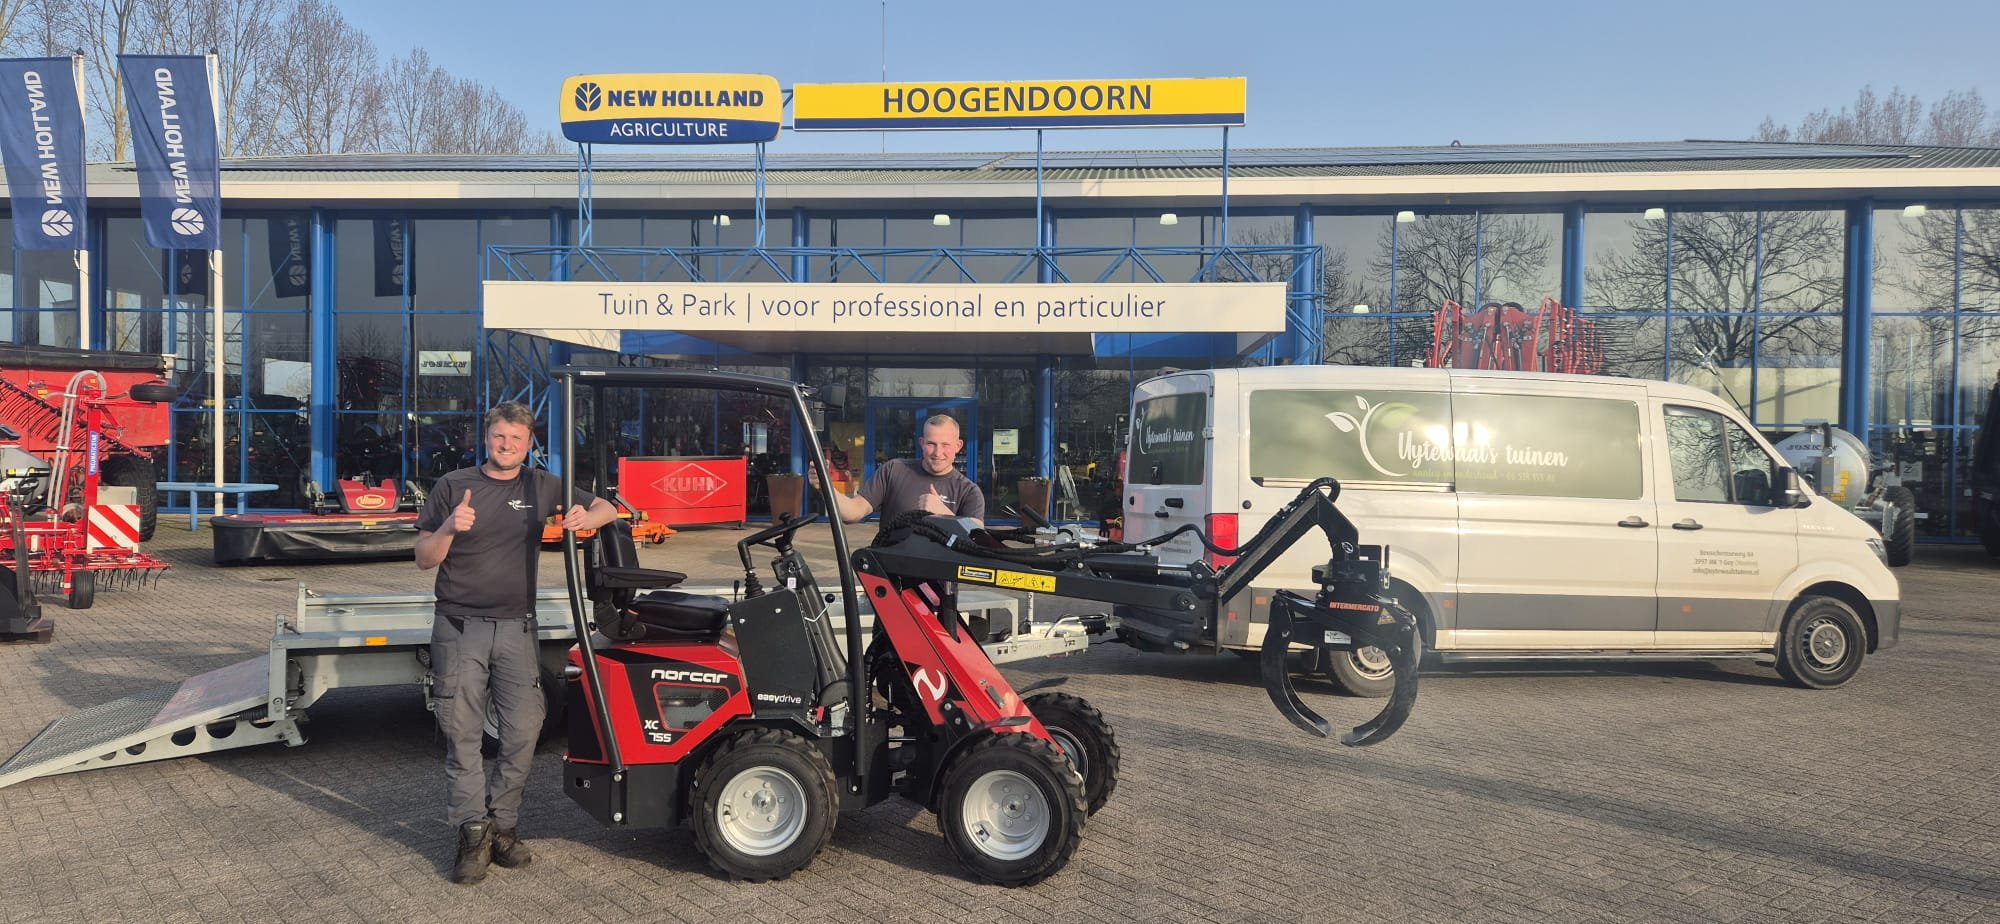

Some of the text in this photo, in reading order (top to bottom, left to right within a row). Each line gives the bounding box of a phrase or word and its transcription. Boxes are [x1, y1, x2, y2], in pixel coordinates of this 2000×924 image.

[608, 90, 764, 107] NEW HOLLAND
[882, 84, 1152, 113] HOOGENDOORN
[610, 122, 728, 137] AGRICULTURE
[598, 292, 648, 316] Tuin
[656, 293, 673, 316] &
[683, 292, 736, 316] Park
[761, 299, 820, 317] voor
[833, 293, 981, 324] professional
[994, 299, 1025, 317] en
[1037, 293, 1166, 324] particulier
[1505, 444, 1568, 467] tuinen
[663, 476, 718, 492] KUHN
[1329, 601, 1380, 612] INTERMERCATO
[651, 668, 729, 684] norcar
[757, 692, 802, 704] easydrive
[644, 719, 660, 730] XC
[648, 732, 672, 743] 755
